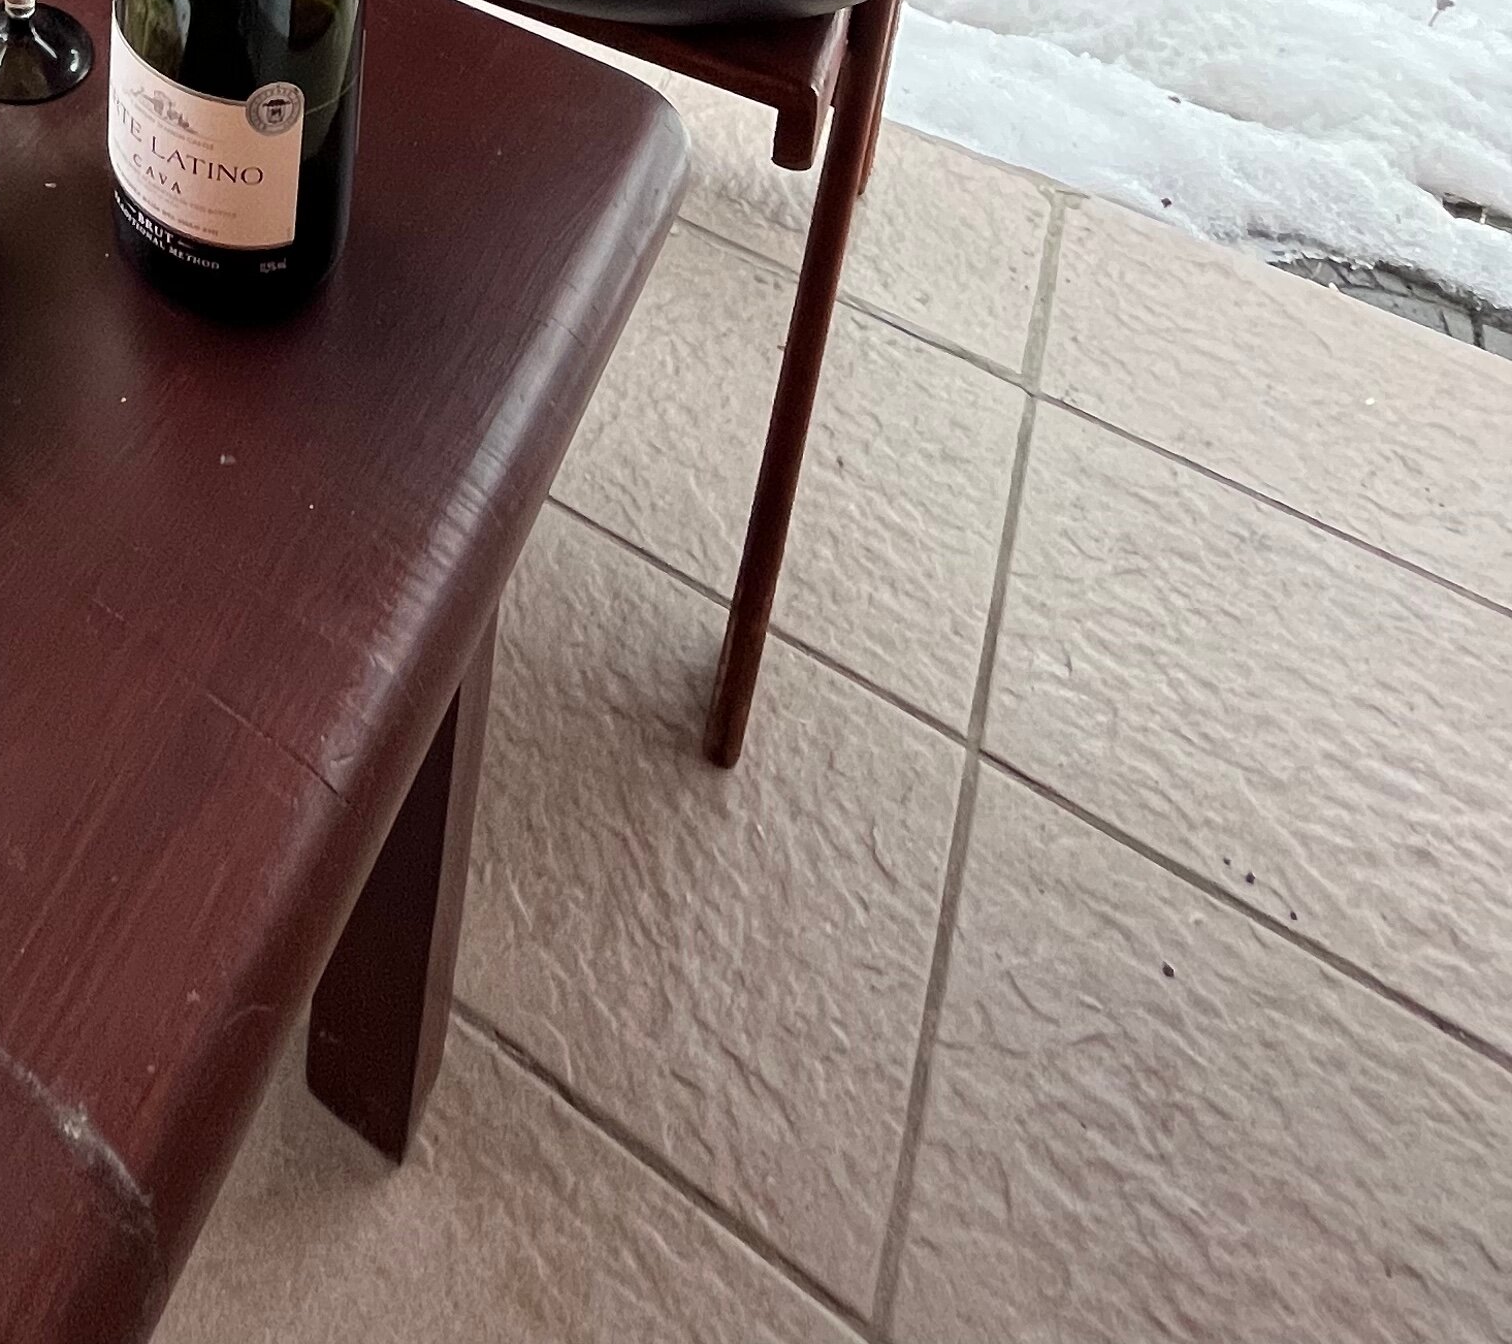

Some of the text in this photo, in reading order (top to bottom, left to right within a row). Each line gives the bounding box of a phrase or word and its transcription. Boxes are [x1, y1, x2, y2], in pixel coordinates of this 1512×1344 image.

[132, 153, 182, 194] CAVA
[152, 135, 264, 186] LATINO
[138, 211, 174, 244] BRUT
[168, 245, 220, 270] METHOD
